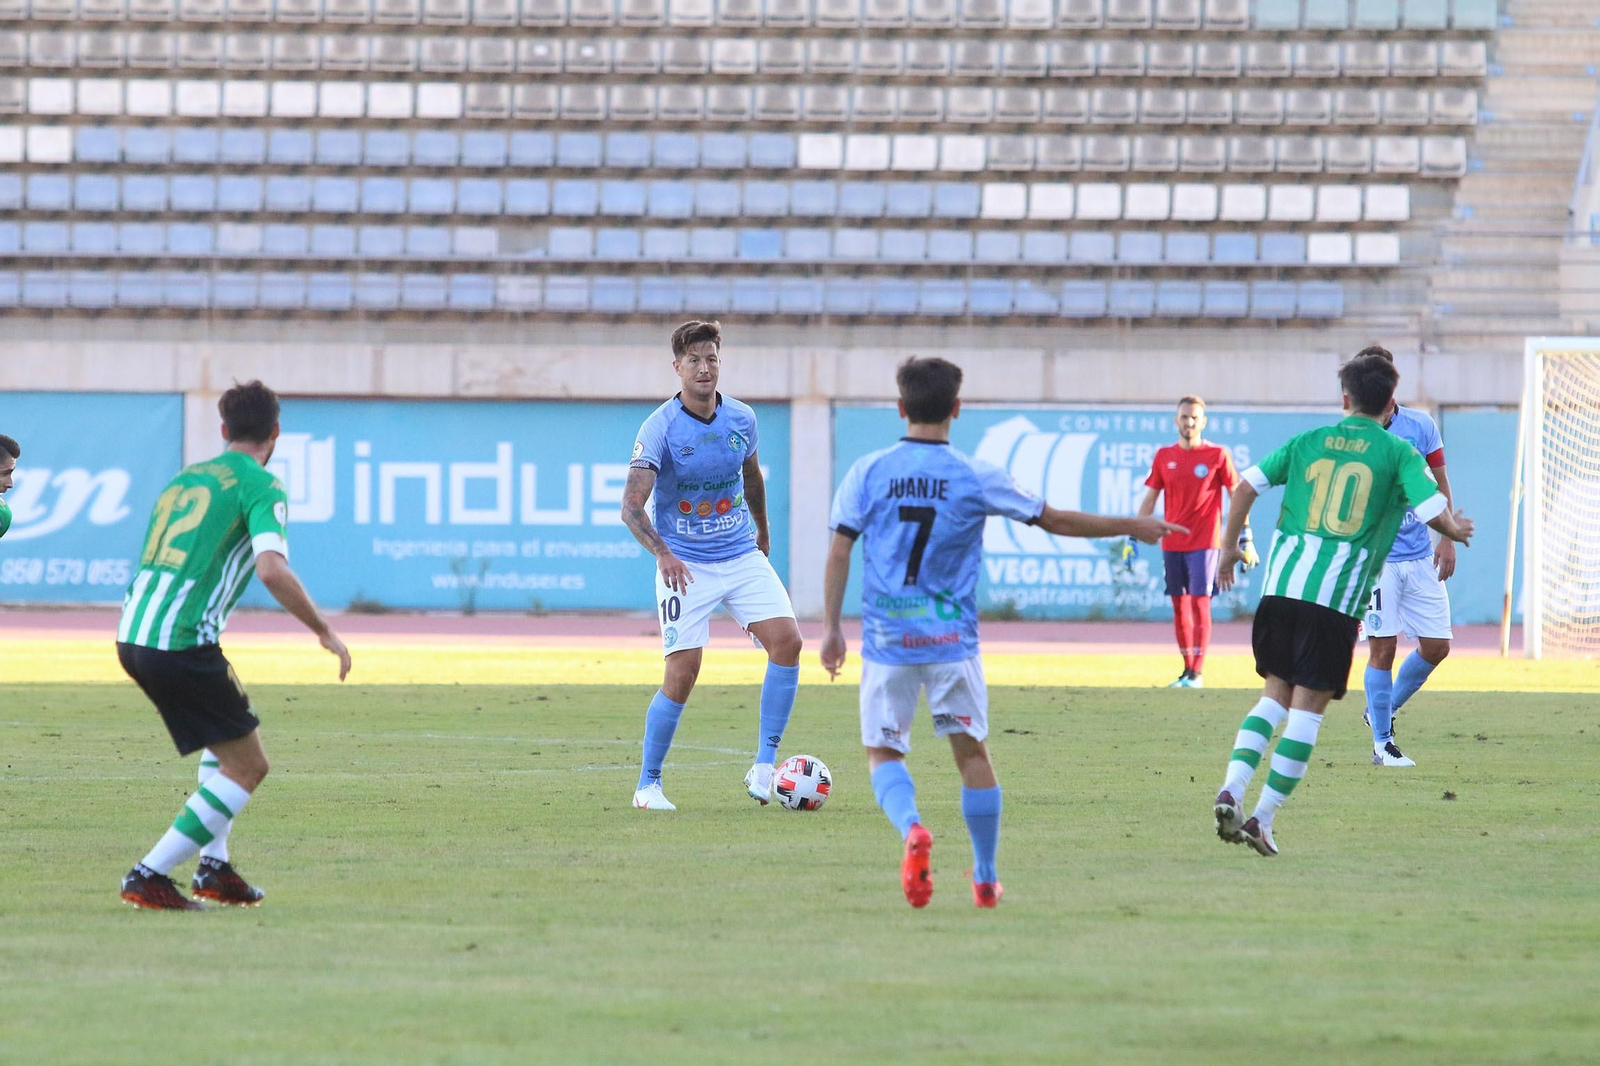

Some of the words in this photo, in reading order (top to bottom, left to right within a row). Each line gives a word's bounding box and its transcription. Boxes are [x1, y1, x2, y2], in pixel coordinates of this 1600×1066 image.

[887, 478, 949, 500] JUANJE
[1305, 458, 1373, 537] 10
[142, 484, 211, 568] 12
[676, 518, 697, 535] EL
[898, 505, 937, 587] 7
[660, 595, 681, 625] 10
[1366, 588, 1382, 611] 1
